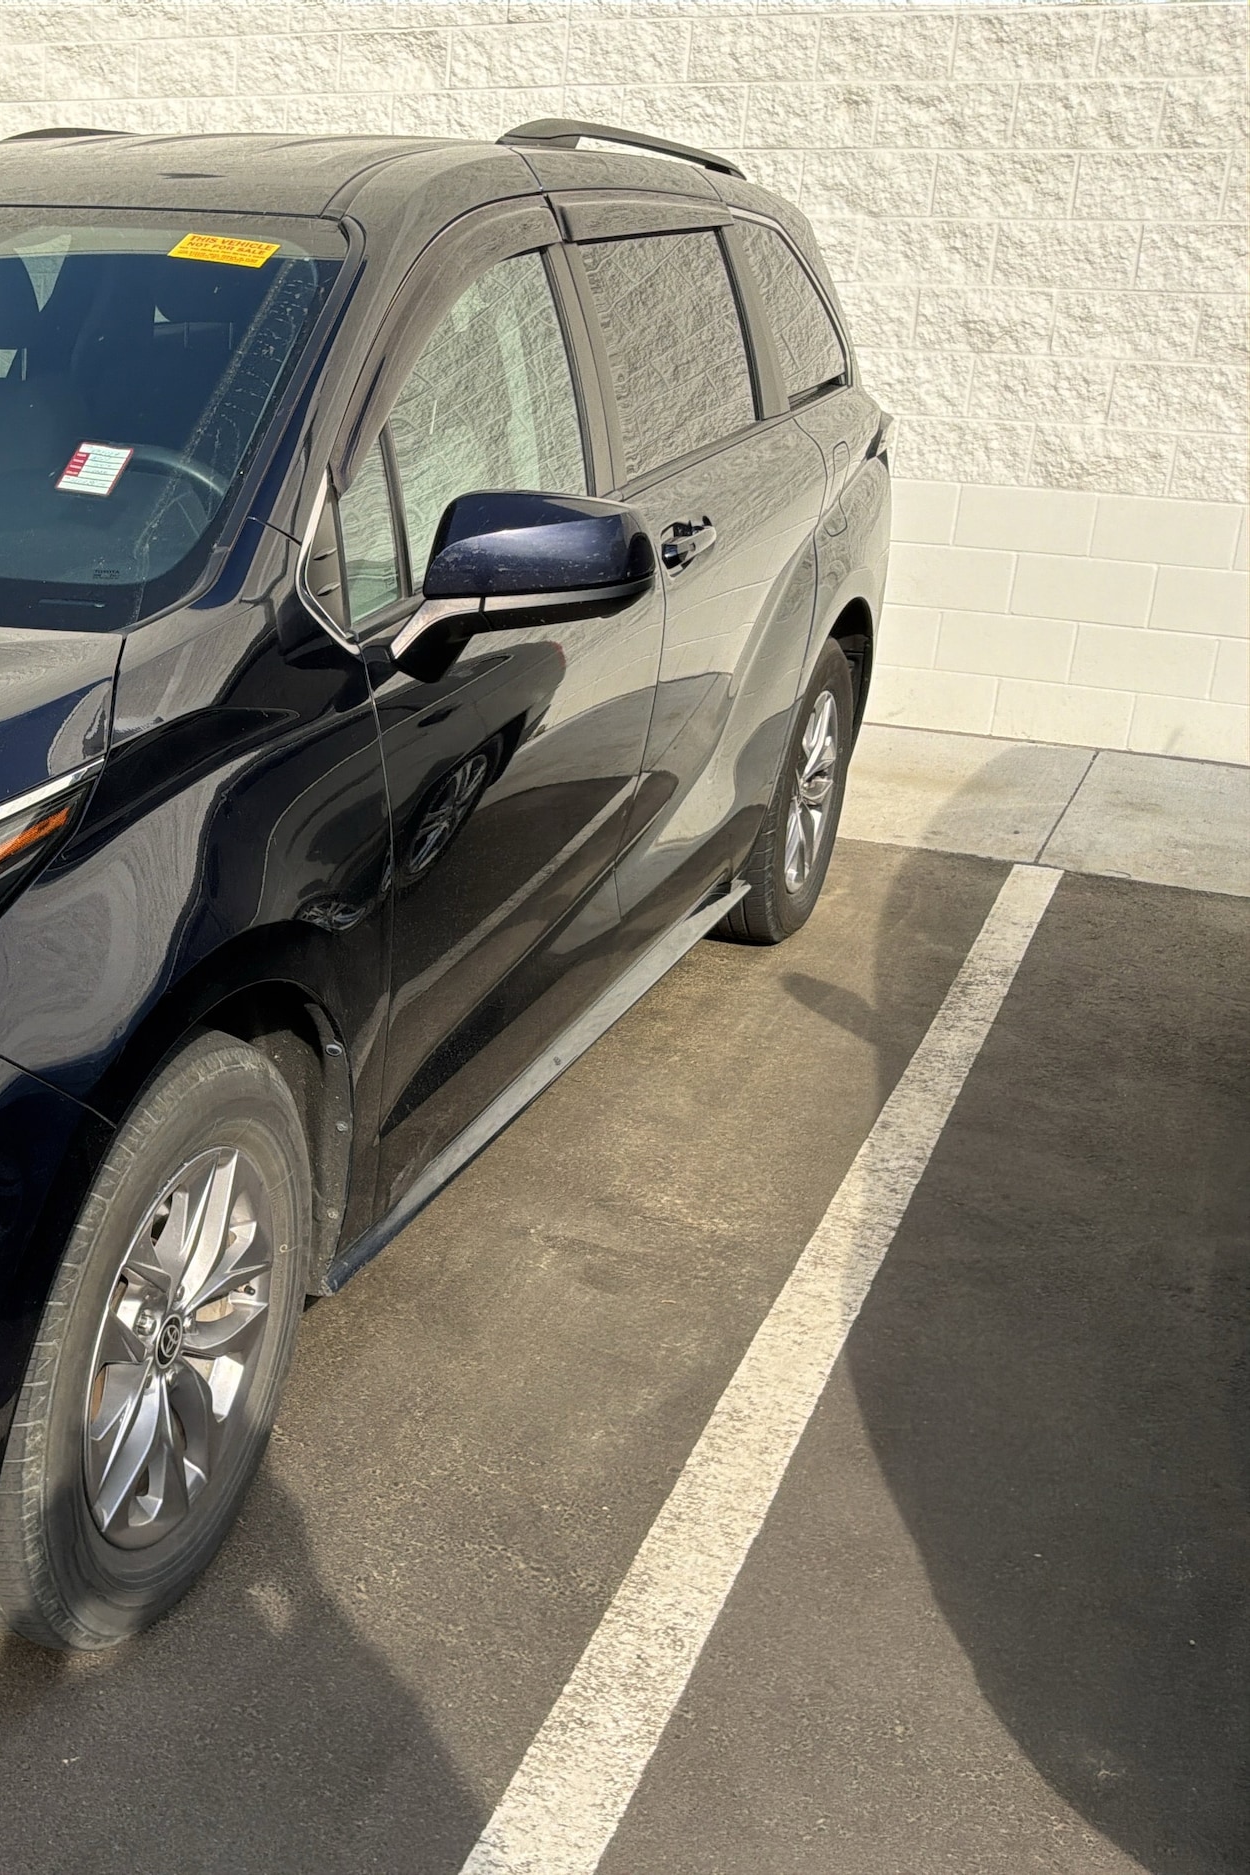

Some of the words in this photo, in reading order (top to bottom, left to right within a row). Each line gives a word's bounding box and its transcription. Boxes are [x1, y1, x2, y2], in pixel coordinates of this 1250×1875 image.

[190, 235, 218, 244] THIS
[222, 239, 275, 251] VEHICLE
[237, 247, 267, 255] SALE
